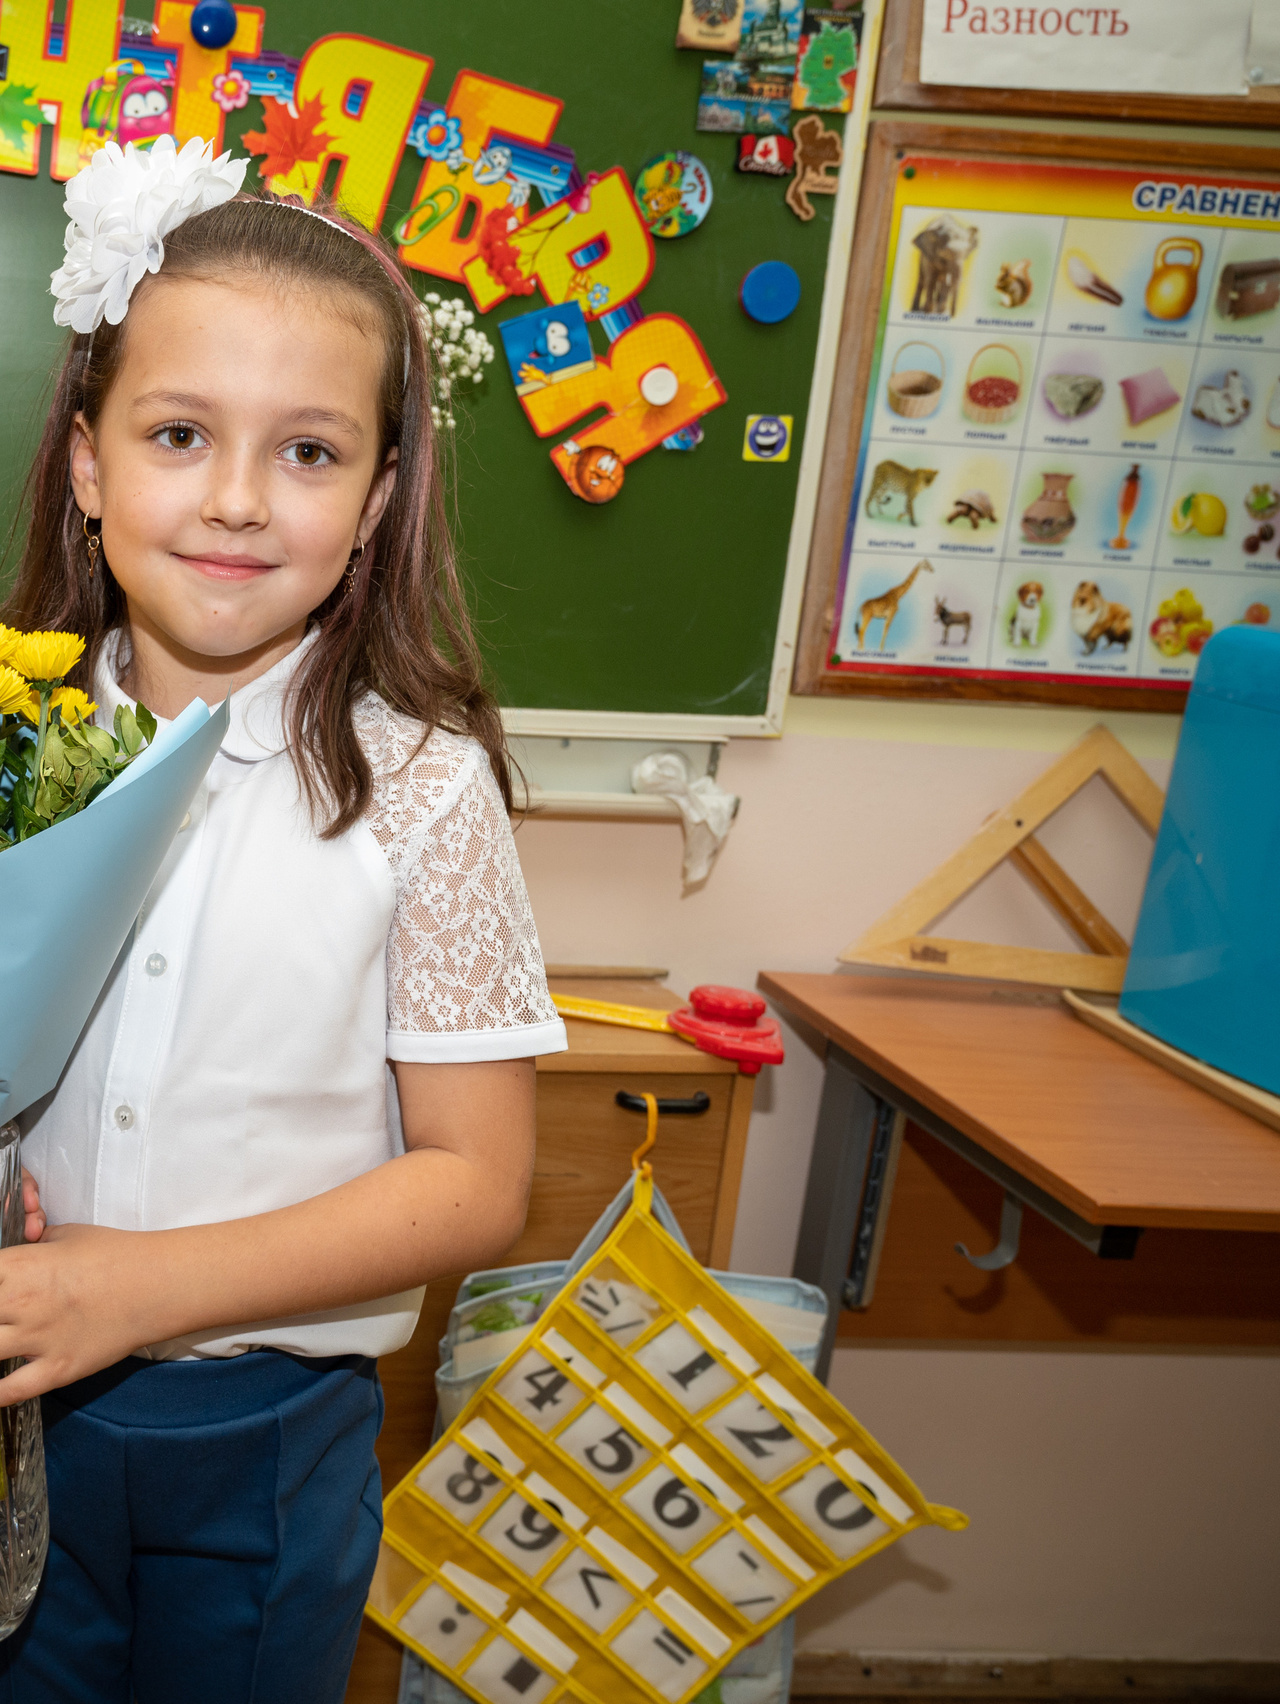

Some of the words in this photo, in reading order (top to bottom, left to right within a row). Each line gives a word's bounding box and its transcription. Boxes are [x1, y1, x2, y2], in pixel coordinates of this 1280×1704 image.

[942, 0, 1129, 36] Разность
[1135, 184, 1280, 219] СРАВНЕН
[522, 1356, 574, 1413] 4
[583, 1425, 642, 1475] 5
[651, 1476, 719, 1530] 6
[667, 1348, 726, 1392] 1
[723, 1401, 799, 1459] 2
[813, 1479, 879, 1532] 0
[445, 1449, 503, 1506] 8
[504, 1498, 566, 1552] 9
